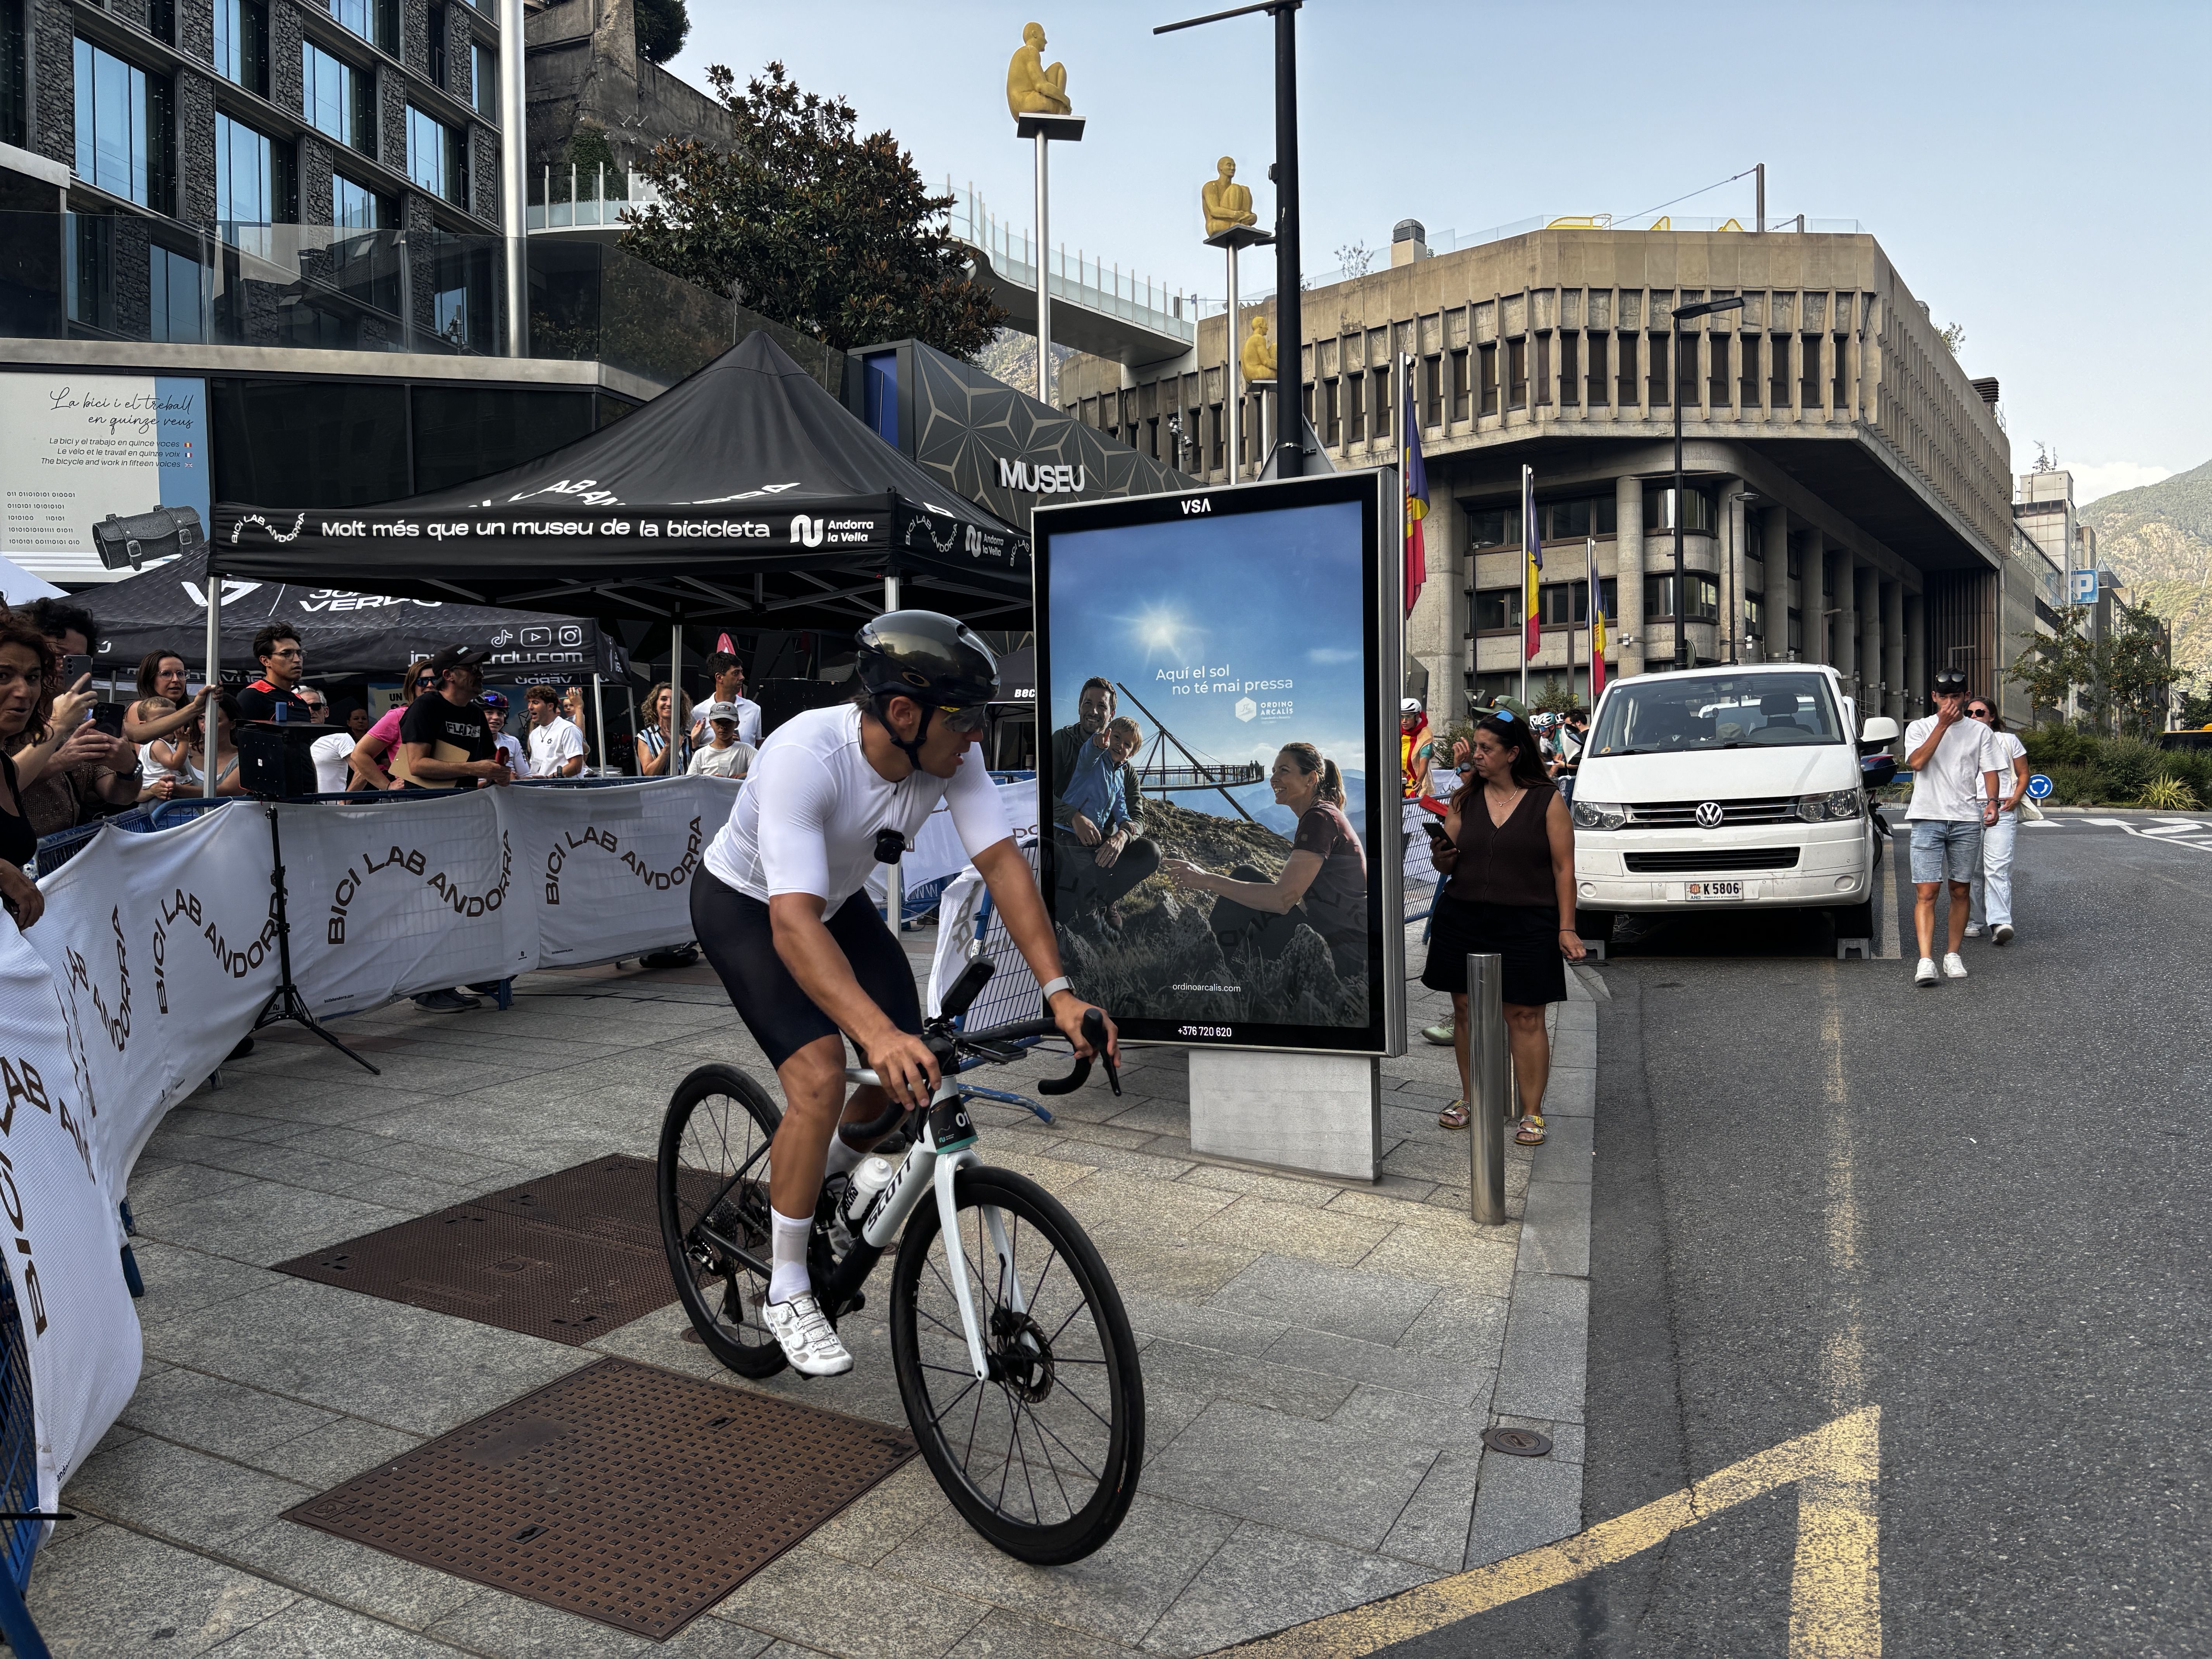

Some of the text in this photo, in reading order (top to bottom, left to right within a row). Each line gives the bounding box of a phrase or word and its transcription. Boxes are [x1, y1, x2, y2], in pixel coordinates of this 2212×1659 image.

[50, 387, 194, 415] La bici i el treball
[109, 415, 160, 434] quinze
[164, 417, 194, 429] veus
[89, 439, 116, 447] trabajo
[129, 440, 155, 448] quince
[56, 458, 84, 467] bicycle
[1000, 458, 1085, 493] MUSEU
[1181, 498, 1211, 515] VSA
[232, 513, 305, 543] BICI LAB ANDORRA
[323, 519, 770, 541] Molt més que un museu de la bicicleta
[828, 520, 874, 530] Andorra
[828, 531, 868, 543] la Vella
[905, 515, 958, 553] BICI LAB ANDORRA
[983, 534, 1004, 546] Andorra
[983, 546, 1001, 556] la Vella
[1018, 540, 1030, 553] LAB
[1156, 664, 1229, 682] Aquí el sol
[1173, 679, 1293, 695] no té mai pressa
[389, 693, 403, 701] UN
[1261, 707, 1293, 716] ARCALÍS
[546, 816, 703, 905] BICI LAB ANDORRA
[328, 830, 512, 945] BICI LAB ANDORRA
[1704, 883, 1739, 895] K 5806
[153, 917, 168, 1014] BICI
[161, 889, 201, 927] LAB
[93, 903, 132, 1053] ANDORRA
[1173, 982, 1241, 993] ordinoarcalis.com
[1178, 1026, 1232, 1037] +376 720 620
[868, 1151, 913, 1233] SCOTT
